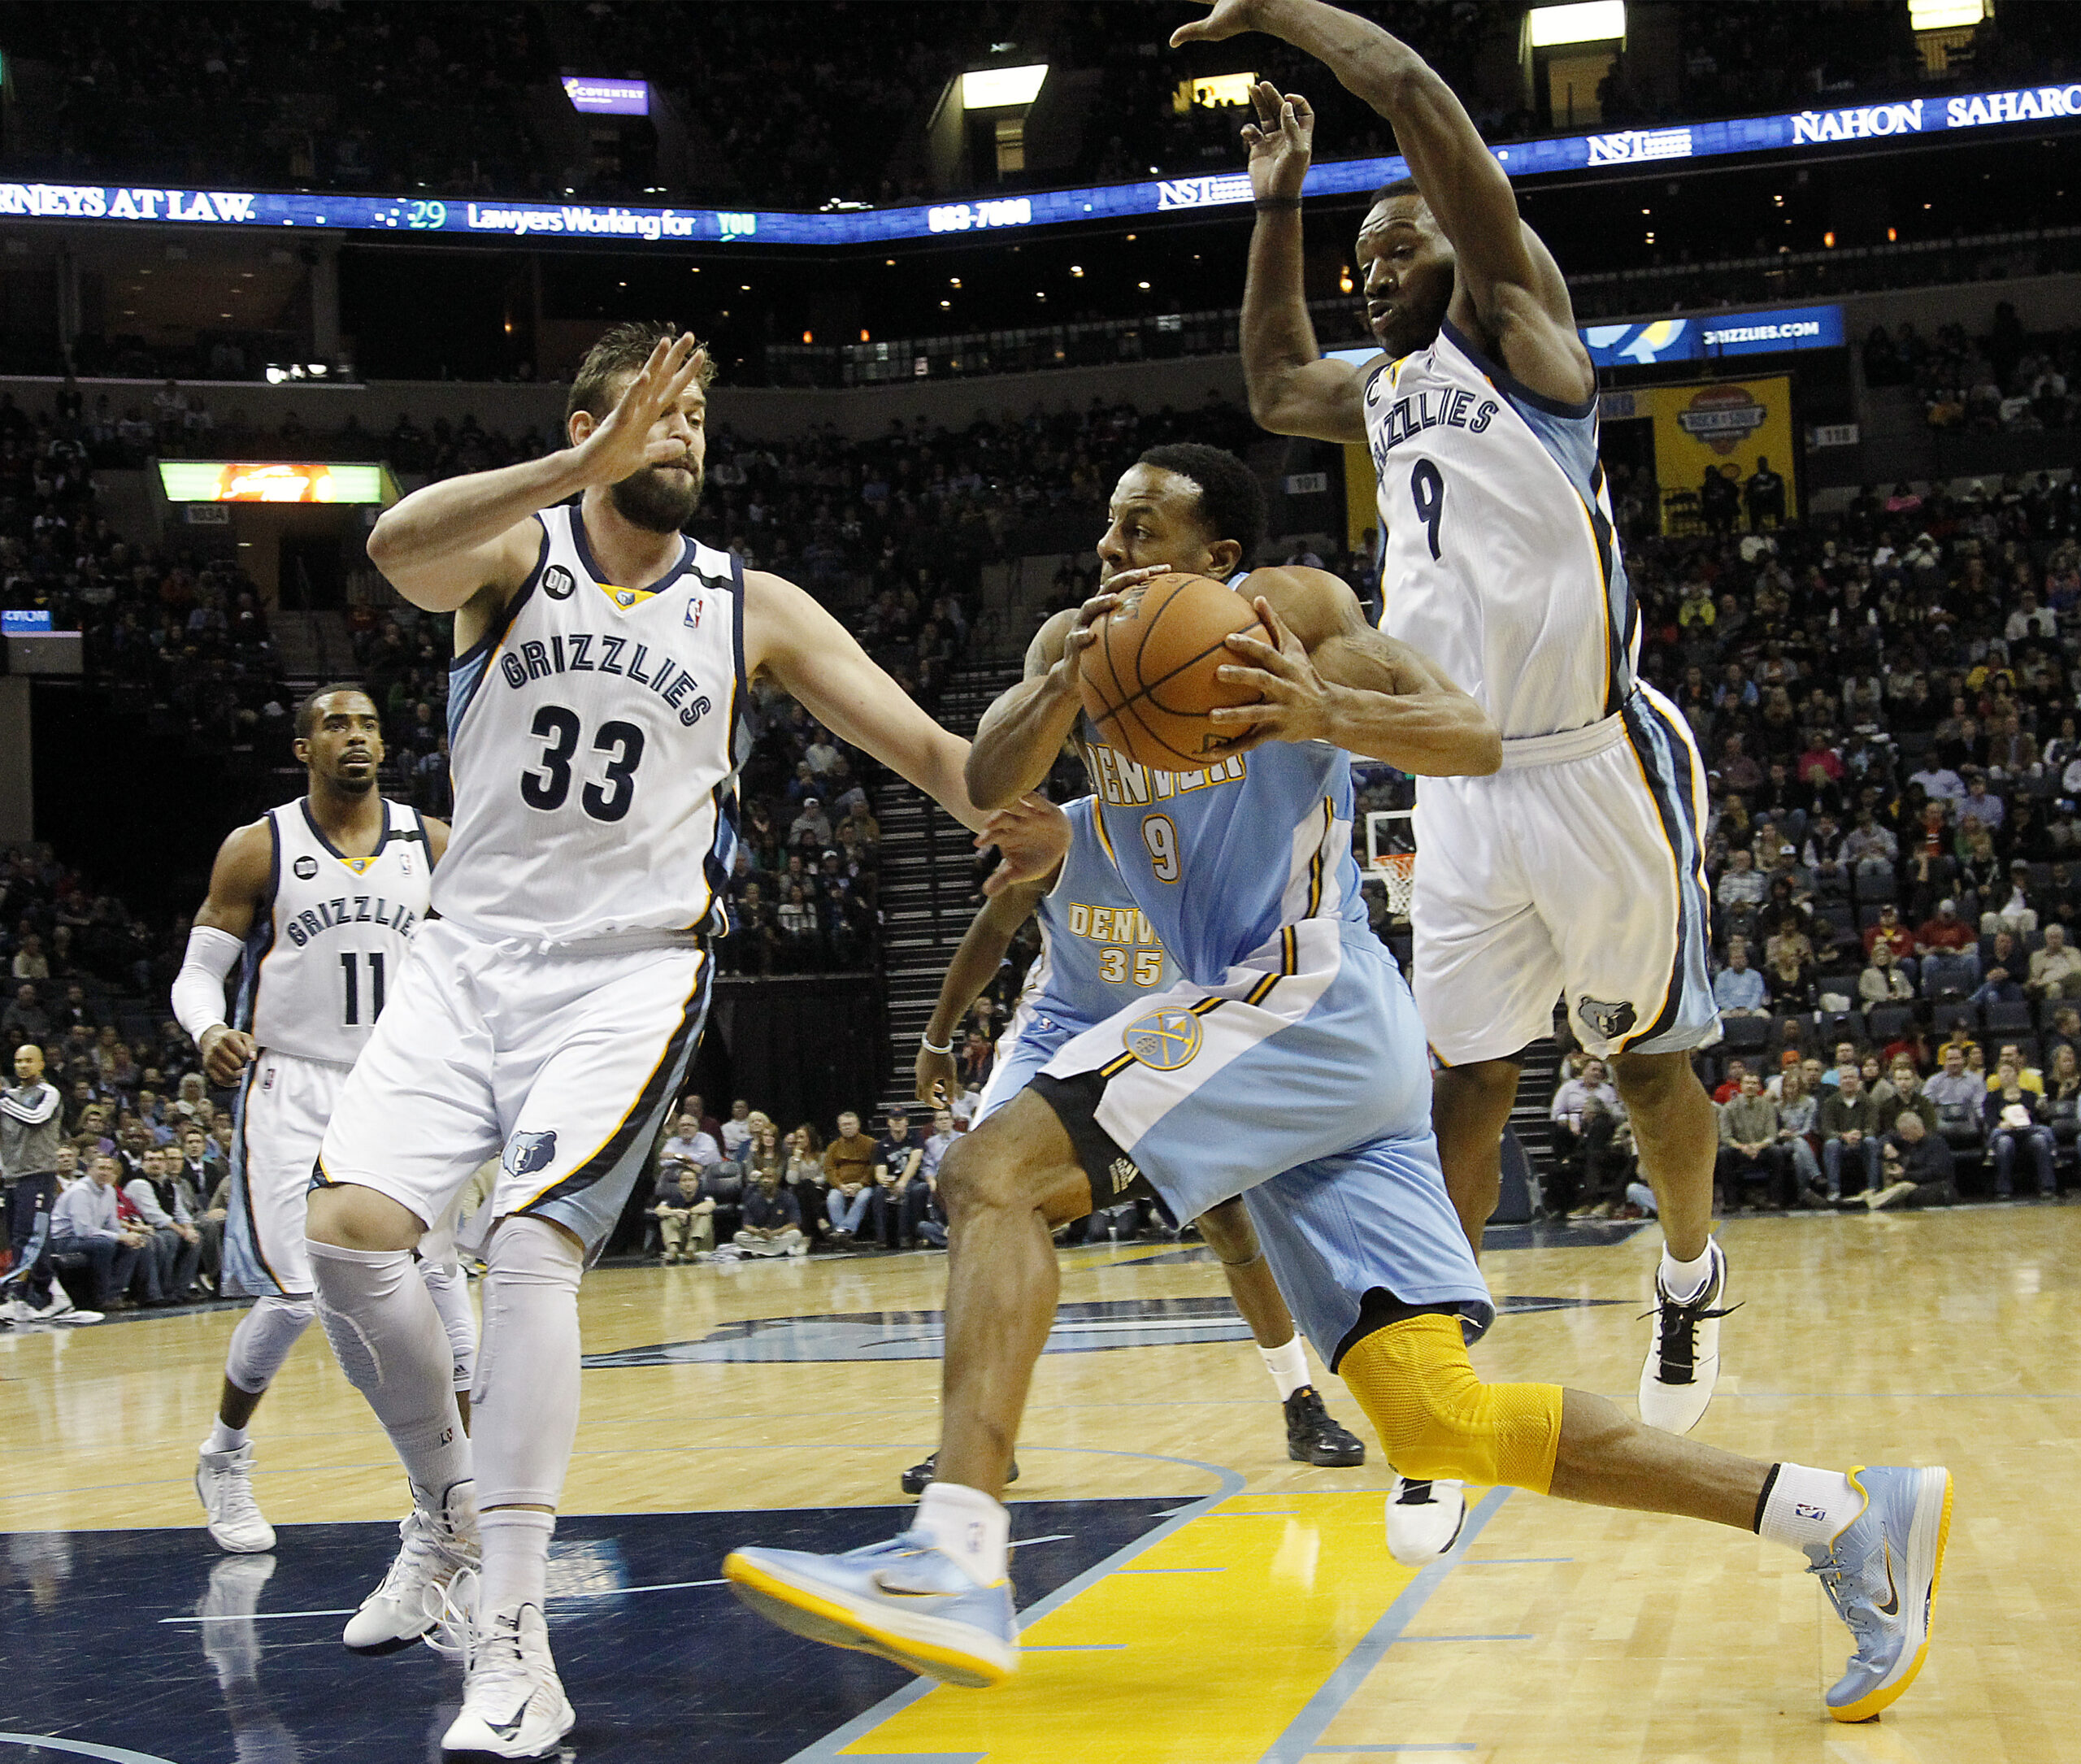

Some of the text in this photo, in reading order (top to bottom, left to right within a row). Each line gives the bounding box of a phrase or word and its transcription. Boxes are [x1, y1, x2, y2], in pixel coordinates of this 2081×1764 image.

[1792, 99, 1923, 146] NAHON
[1586, 131, 1650, 162] NST
[107, 188, 164, 219] AT
[165, 189, 256, 222] LAW.
[1156, 176, 1217, 206] NST
[467, 203, 756, 240] Lawyers Working for YOU
[1410, 458, 1445, 562] 9
[501, 634, 711, 727] GRIZZLIES
[519, 703, 645, 823] 33
[1141, 813, 1182, 884] 9
[338, 950, 385, 1026] 11
[1099, 946, 1164, 988] 35
